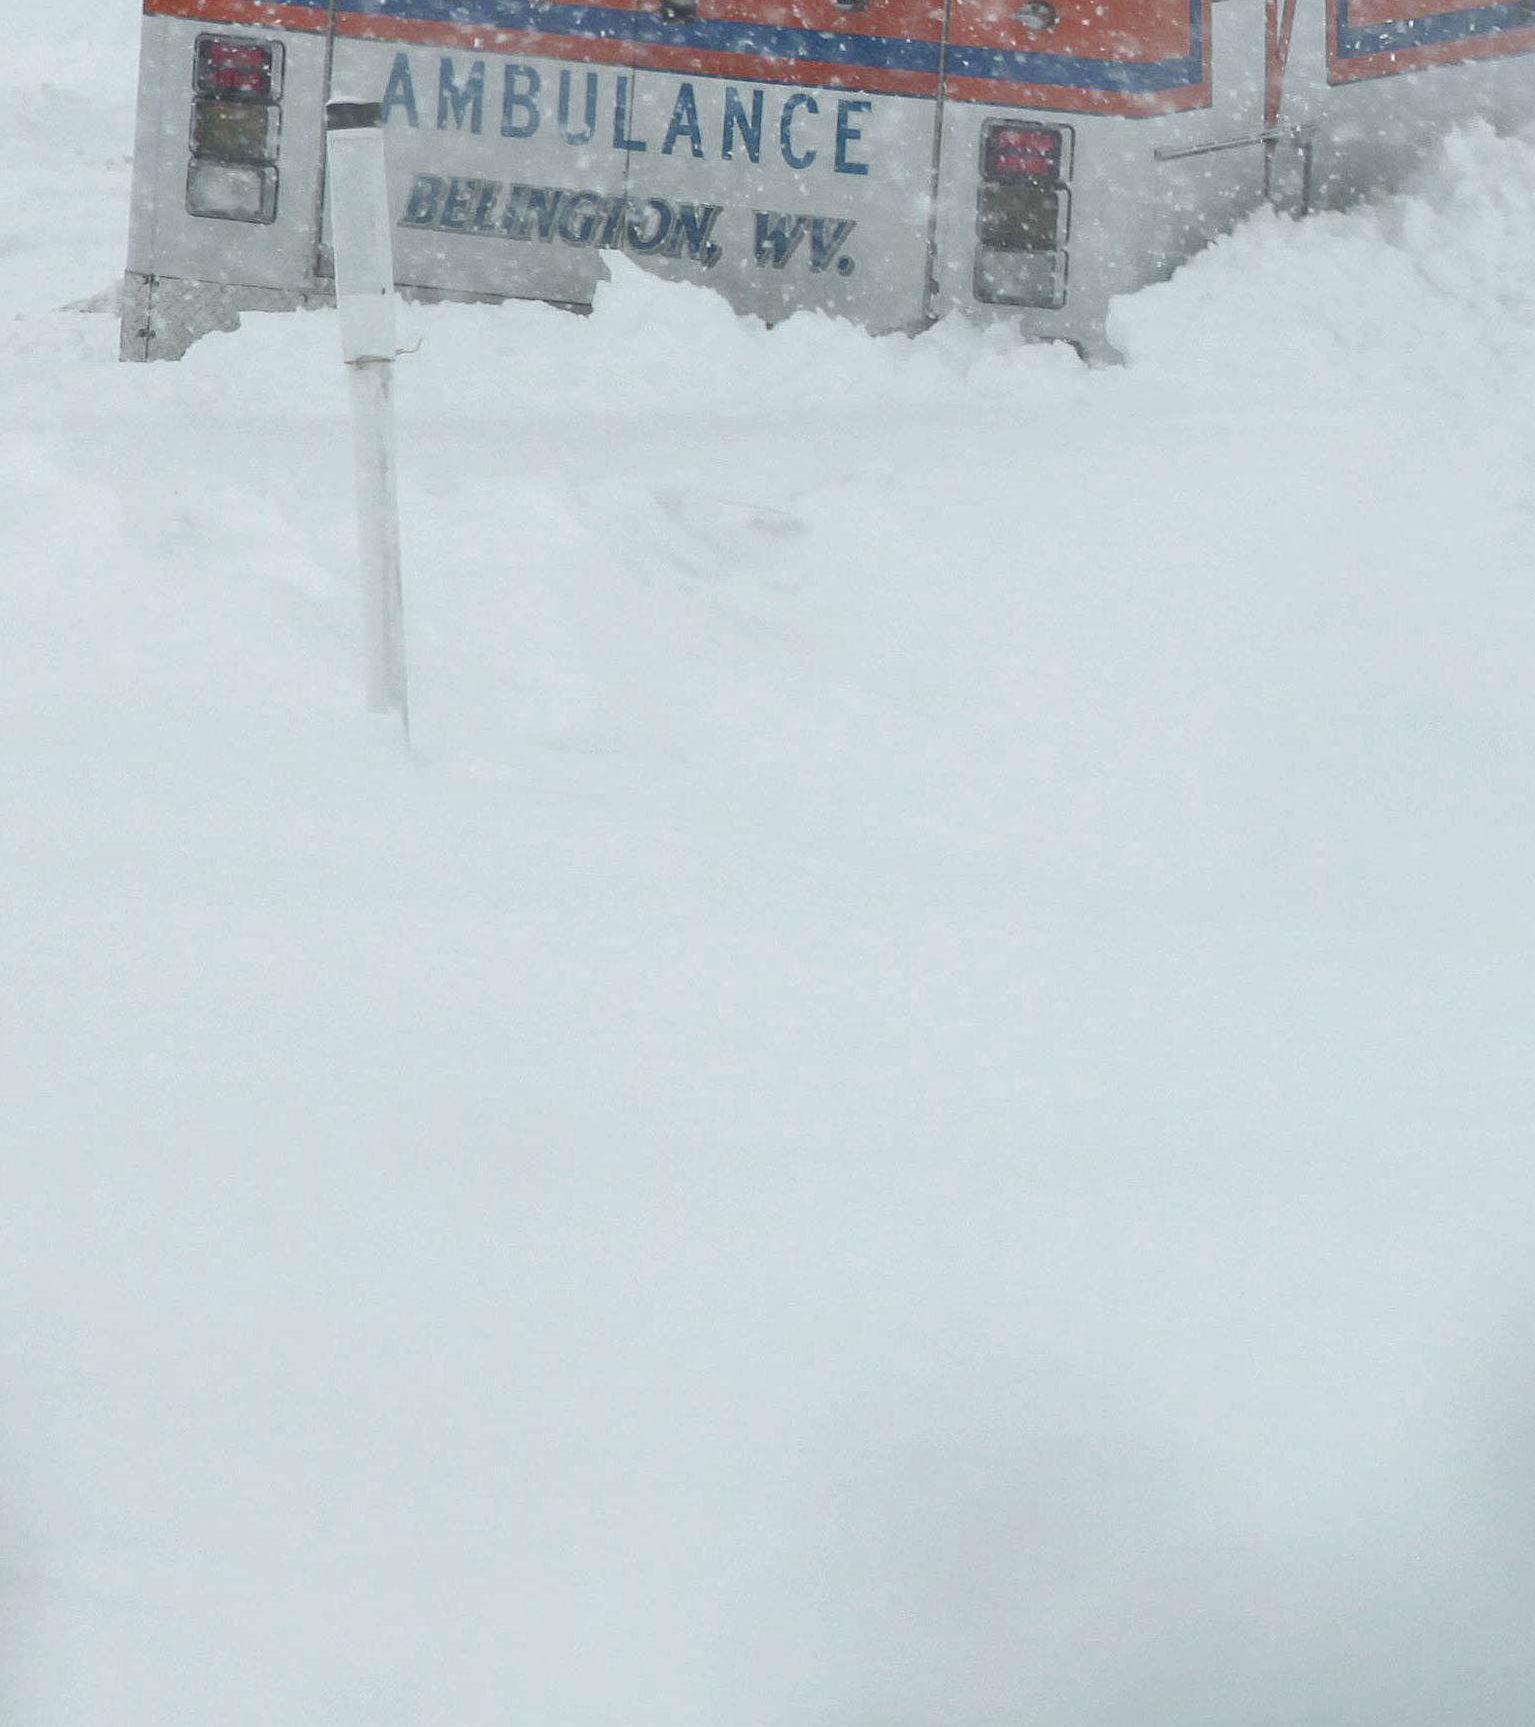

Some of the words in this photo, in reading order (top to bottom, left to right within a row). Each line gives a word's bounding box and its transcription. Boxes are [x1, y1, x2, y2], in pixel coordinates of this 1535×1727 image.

[382, 51, 873, 175] AMBULANCE
[397, 173, 724, 269] BELINGTON,
[751, 208, 858, 277] WV.
